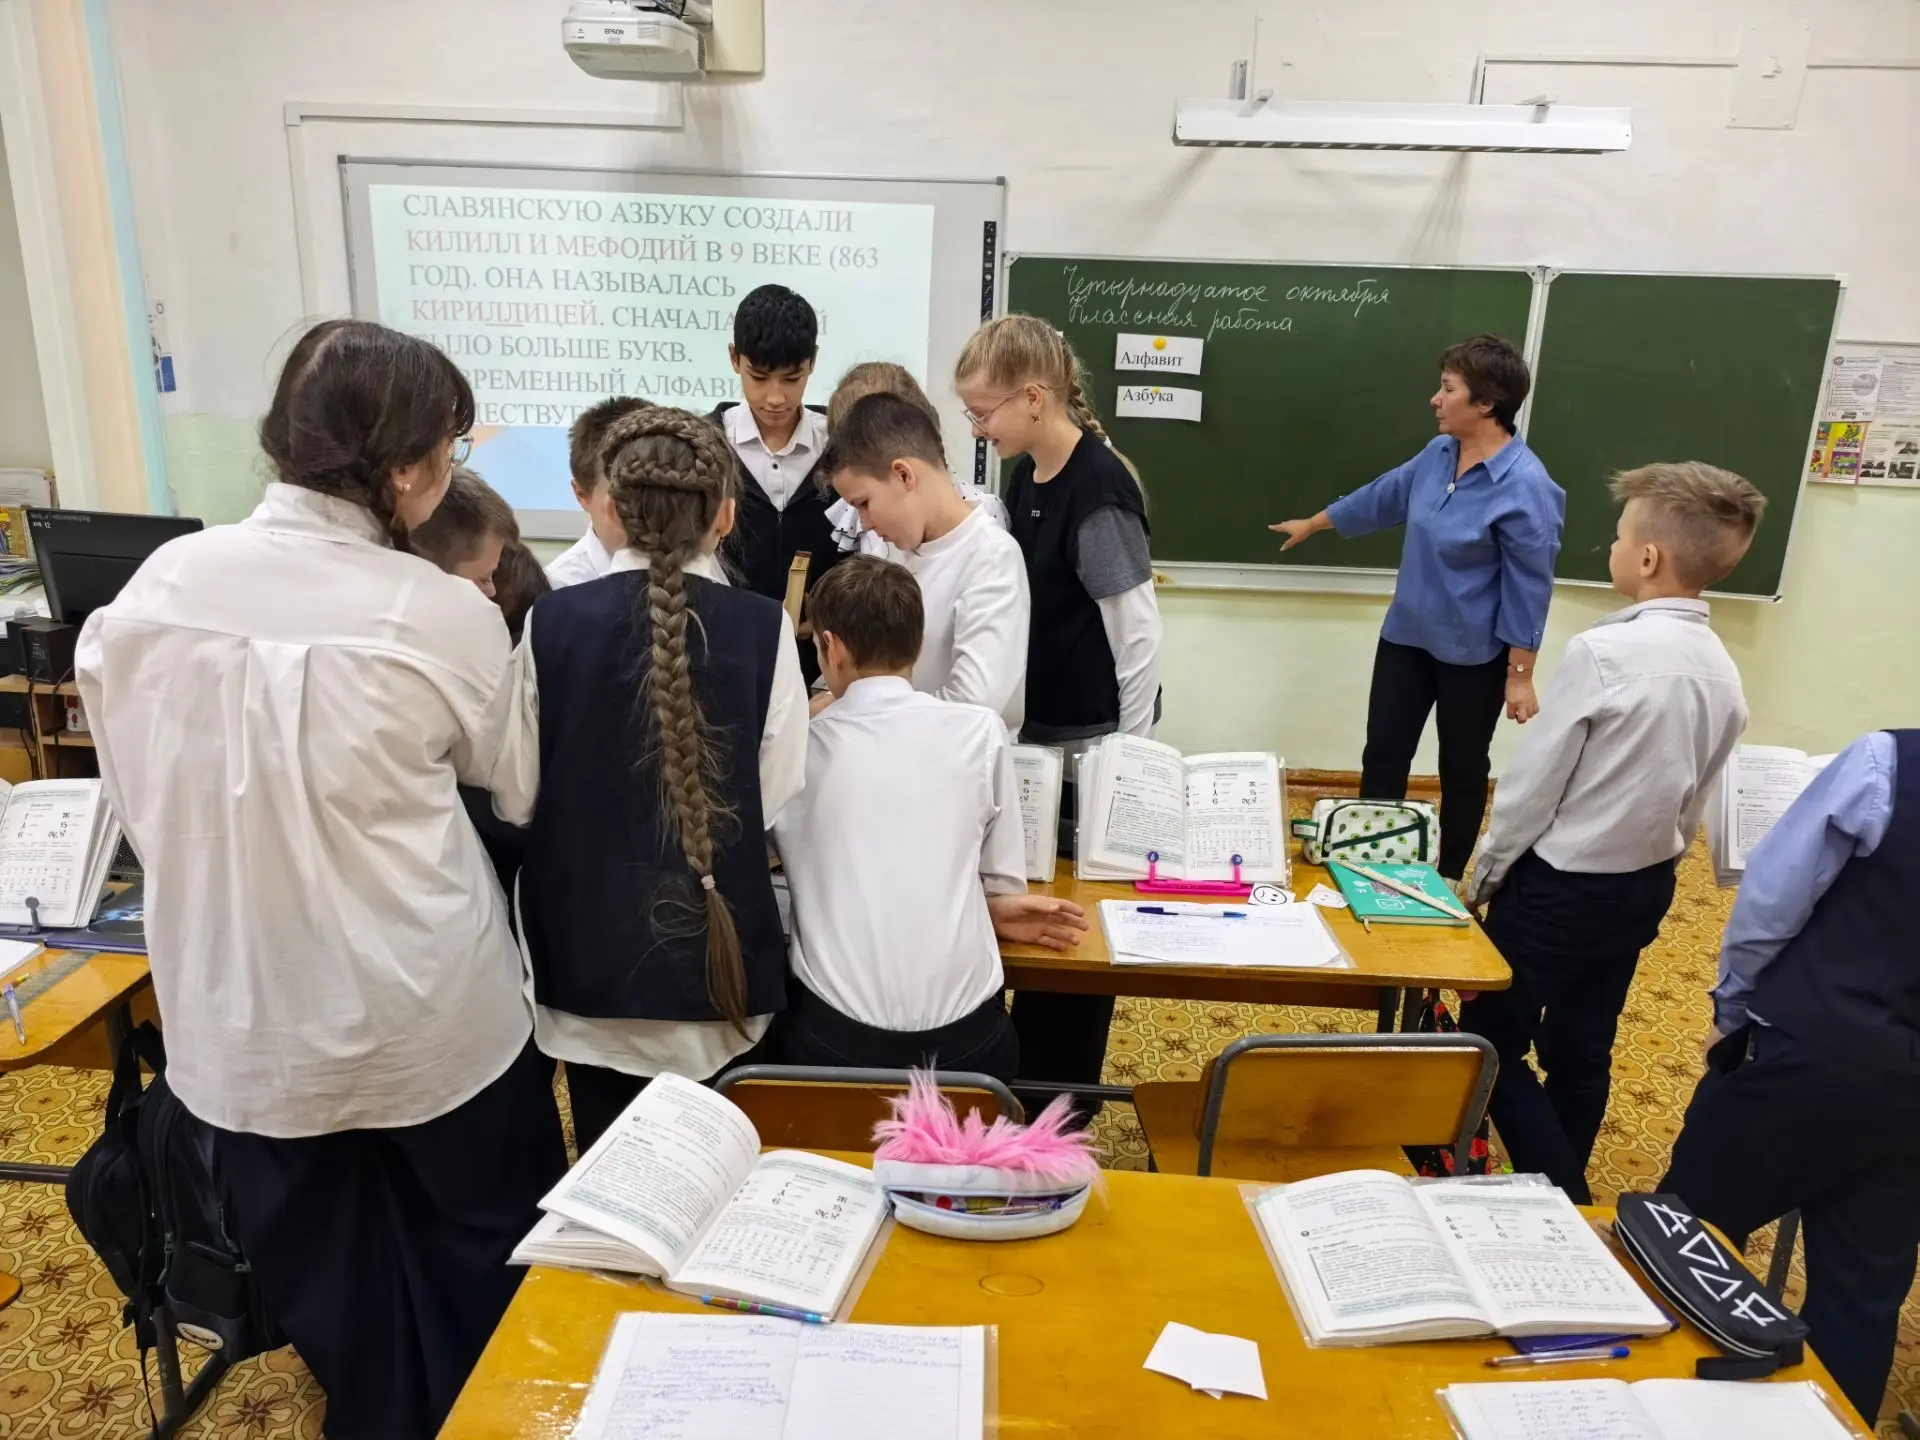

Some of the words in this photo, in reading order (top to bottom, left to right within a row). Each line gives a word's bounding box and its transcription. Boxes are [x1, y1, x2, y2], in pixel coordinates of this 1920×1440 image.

[403, 194, 602, 222] СЛАВЯНСКУЮ
[610, 202, 715, 227] АЗБУКУ
[723, 206, 854, 233] СОЗДАЛИ
[405, 230, 520, 254] КИЛИЛЛ
[529, 234, 547, 255] И
[555, 234, 698, 264] МЕФОДИЙ
[705, 241, 722, 263] В
[731, 242, 743, 263] 9
[751, 243, 822, 267] ВЕКЕ
[829, 246, 879, 273] (863
[408, 264, 477, 292] ГОД).
[485, 266, 544, 290] ОНА
[552, 269, 736, 297] НАЗЫВАЛАСЬ
[1063, 264, 1269, 316] Четырнадцатое
[1286, 279, 1390, 317] октября
[411, 299, 605, 328] КИРИЛЛИЦЕЙ.
[1207, 308, 1293, 342] работа
[500, 337, 610, 360] БОЛЬШЕ
[618, 340, 693, 363] БУКВ.
[1120, 351, 1184, 368] Алфавит
[1123, 388, 1173, 405] Азбука
